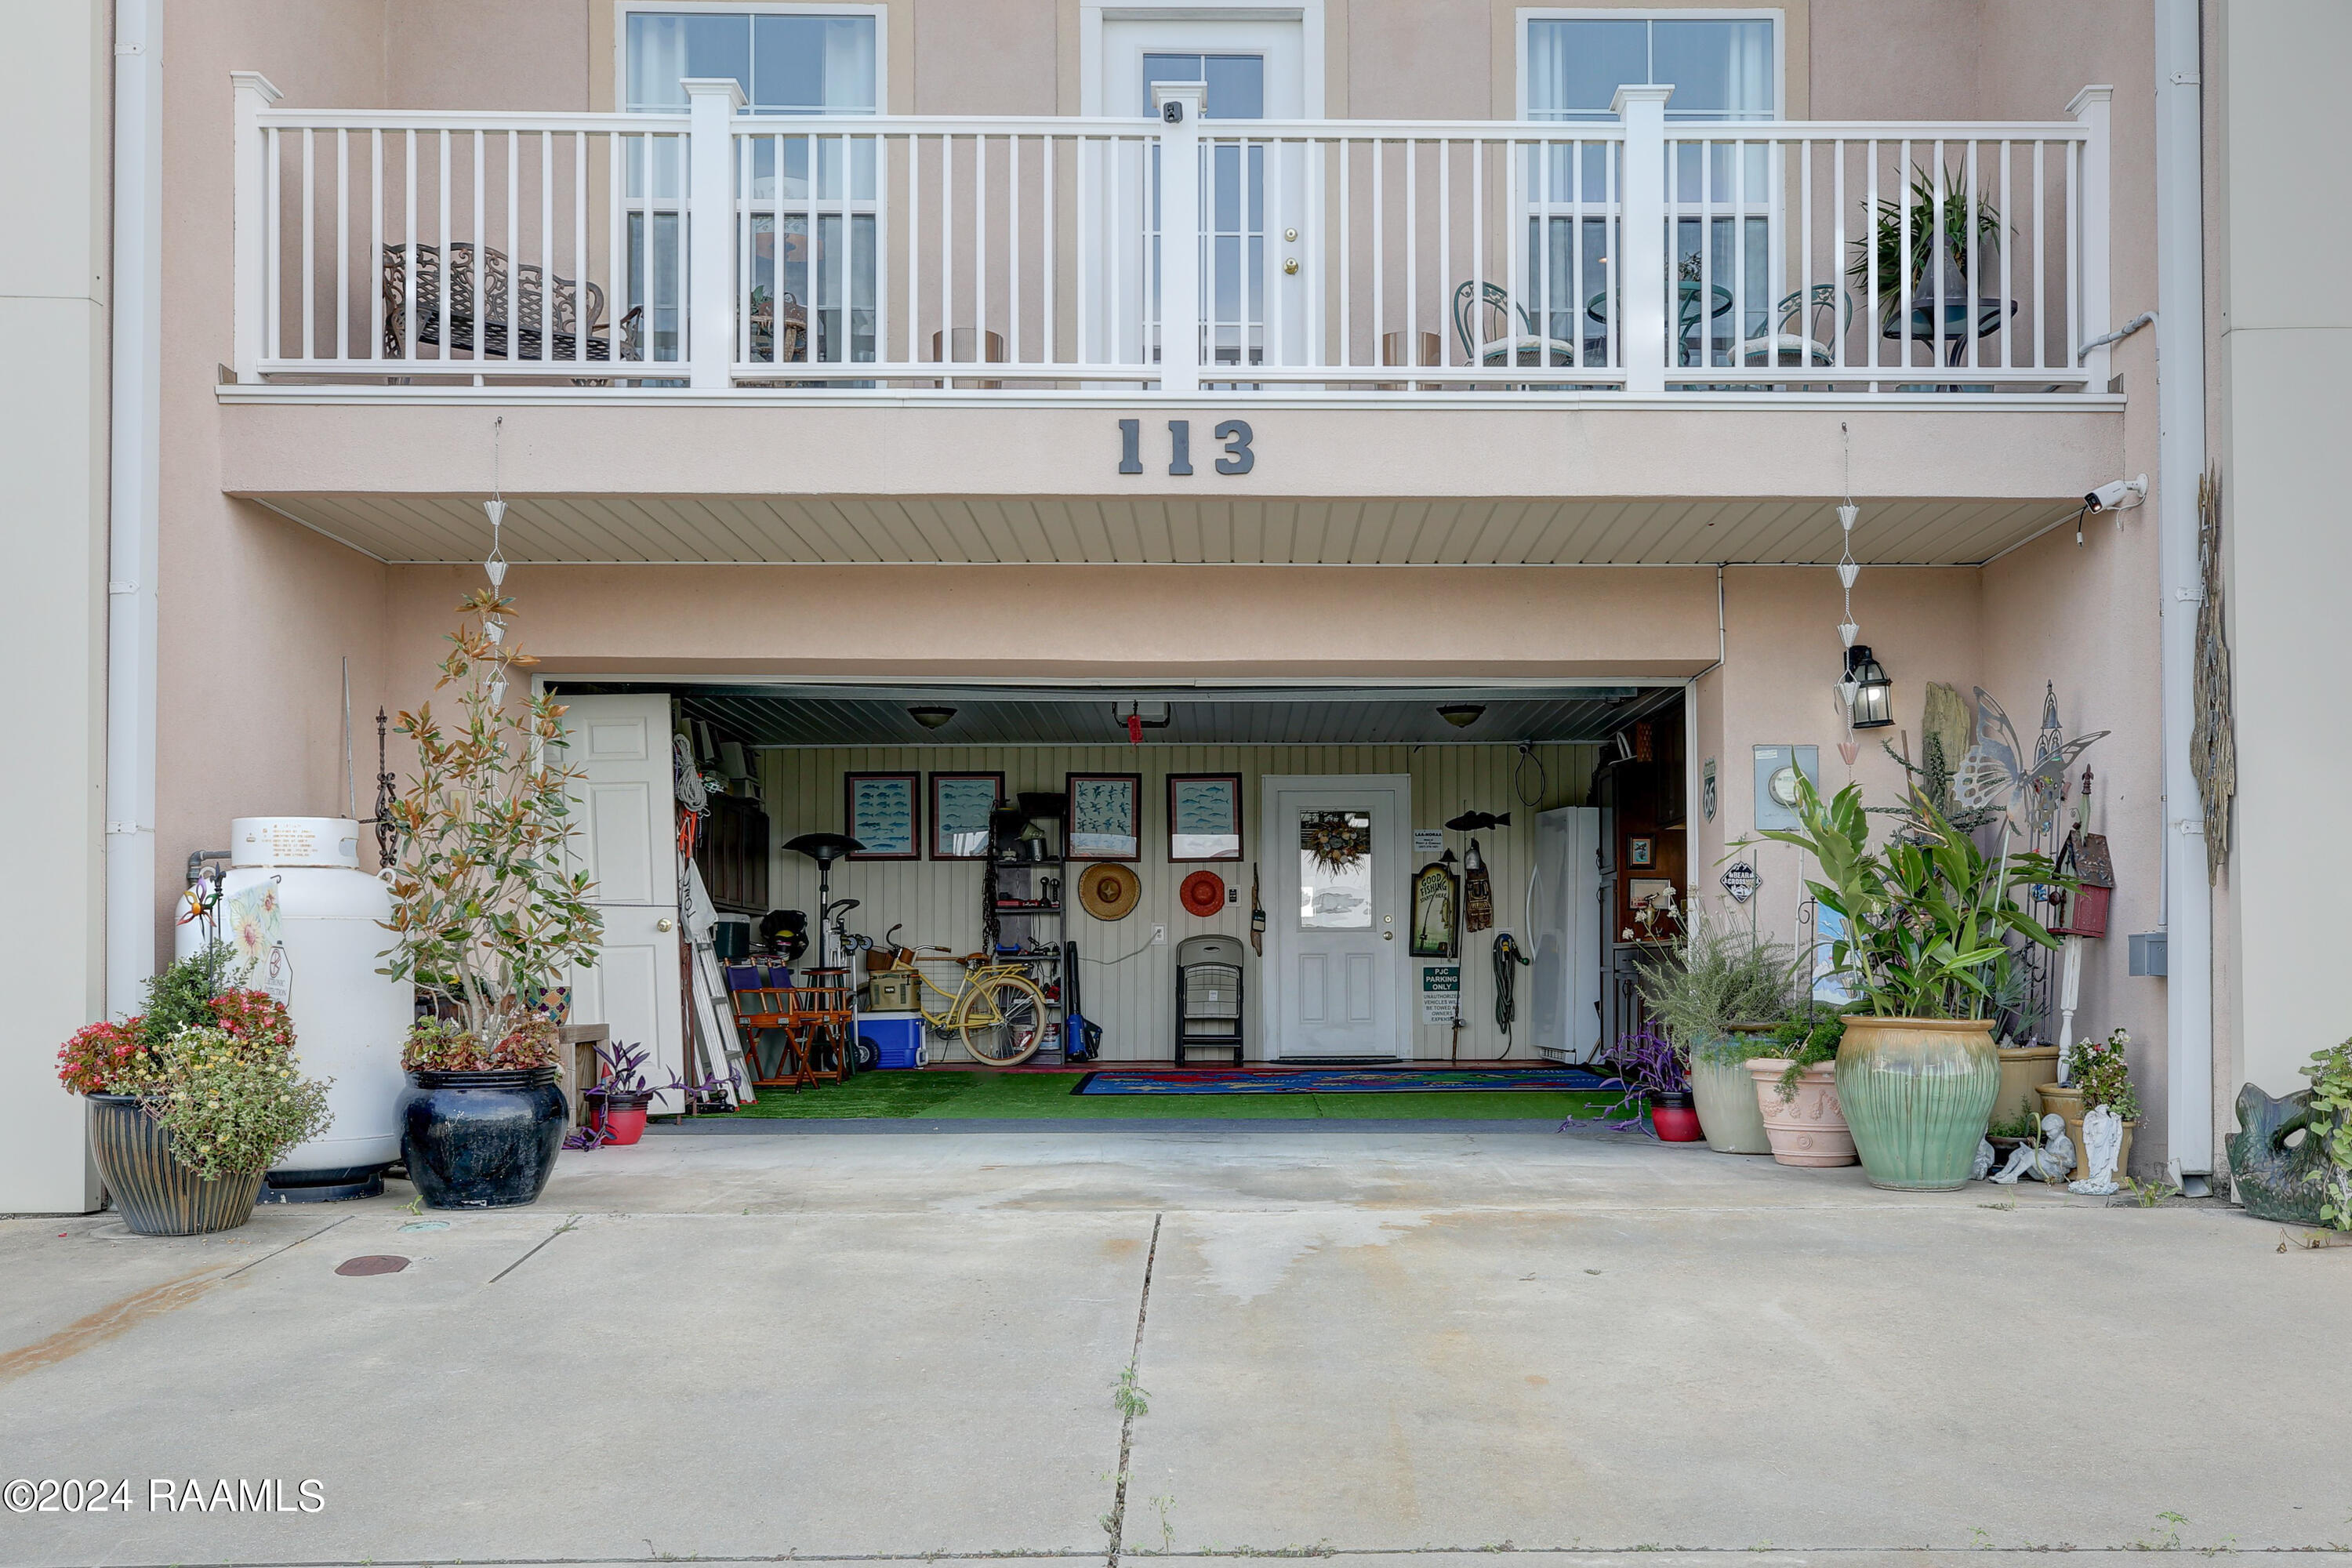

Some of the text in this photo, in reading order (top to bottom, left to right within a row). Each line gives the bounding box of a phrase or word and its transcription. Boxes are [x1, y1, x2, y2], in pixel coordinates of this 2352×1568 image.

[1119, 419, 1254, 475] 113
[1704, 782, 1715, 814] 66
[1420, 880, 1447, 897] FISHING
[1421, 873, 1442, 887] GOOD
